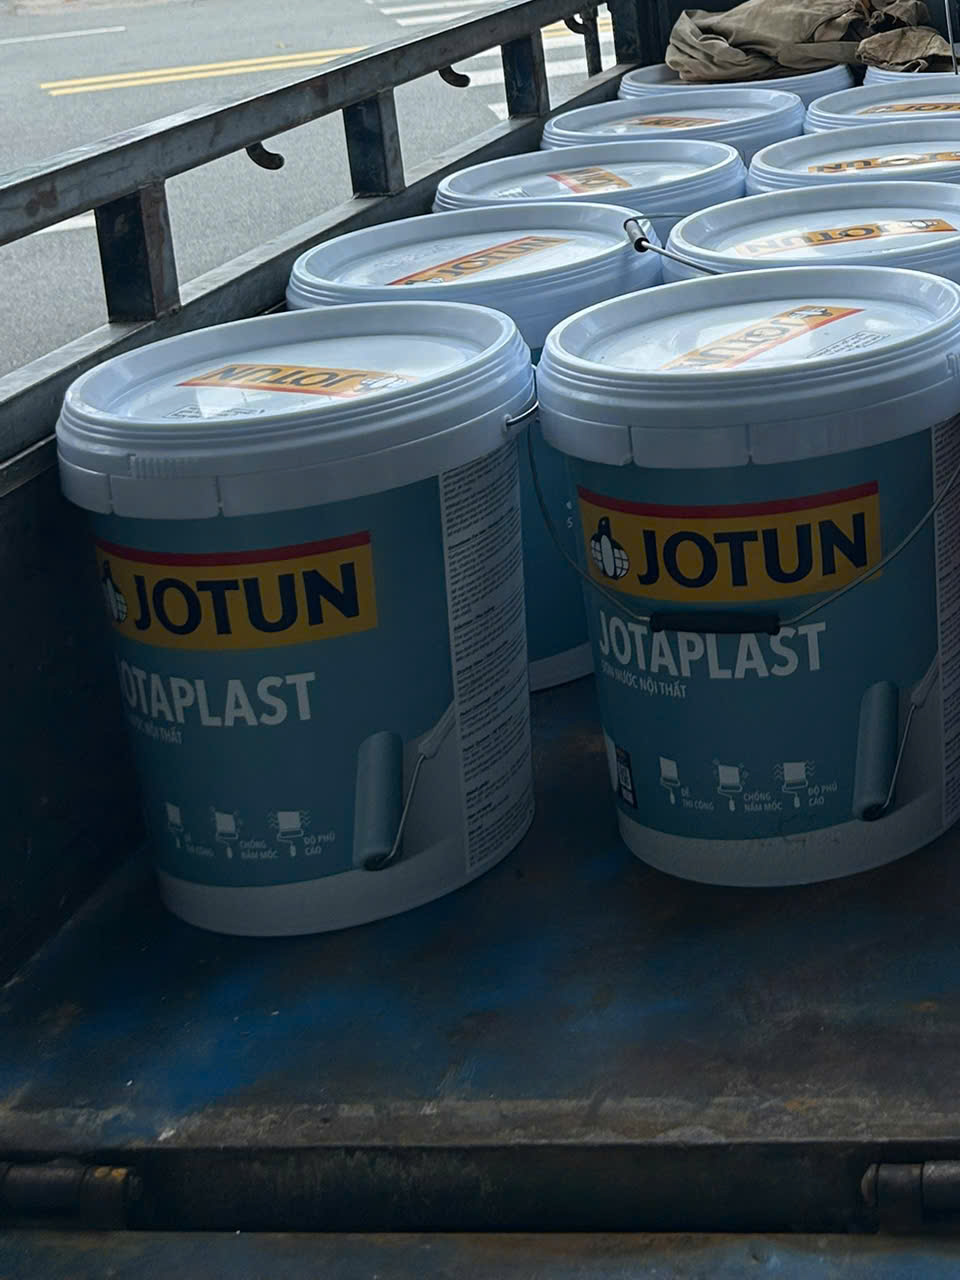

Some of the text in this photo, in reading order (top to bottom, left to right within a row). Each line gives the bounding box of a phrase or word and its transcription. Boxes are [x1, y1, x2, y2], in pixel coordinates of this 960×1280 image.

[637, 512, 868, 589] JOTUN
[134, 561, 360, 635] JOTUN
[599, 609, 827, 680] JOTAPLAST
[658, 680, 687, 699] THẤT
